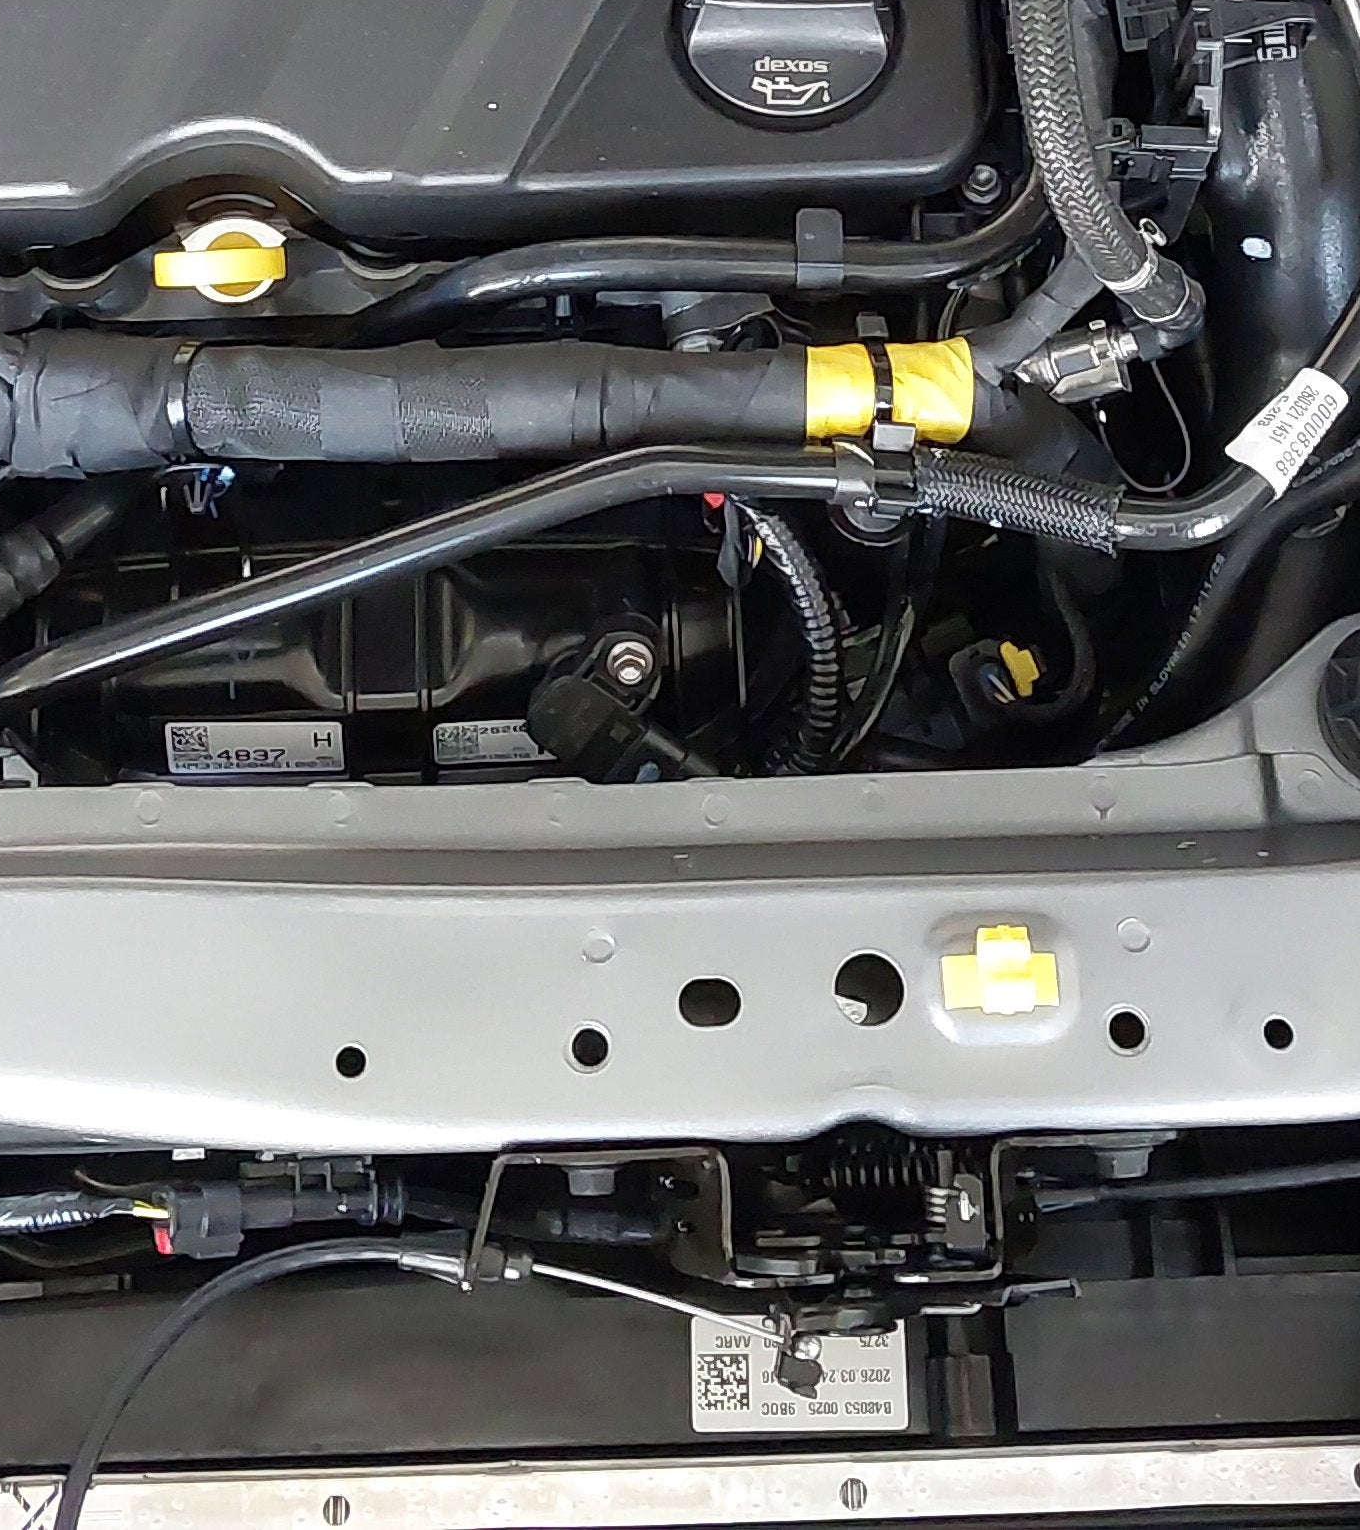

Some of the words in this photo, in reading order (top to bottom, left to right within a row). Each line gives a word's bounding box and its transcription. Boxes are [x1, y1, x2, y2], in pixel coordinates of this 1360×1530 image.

[754, 56, 831, 73] dexos
[313, 731, 332, 748] H
[216, 748, 286, 761] 4837
